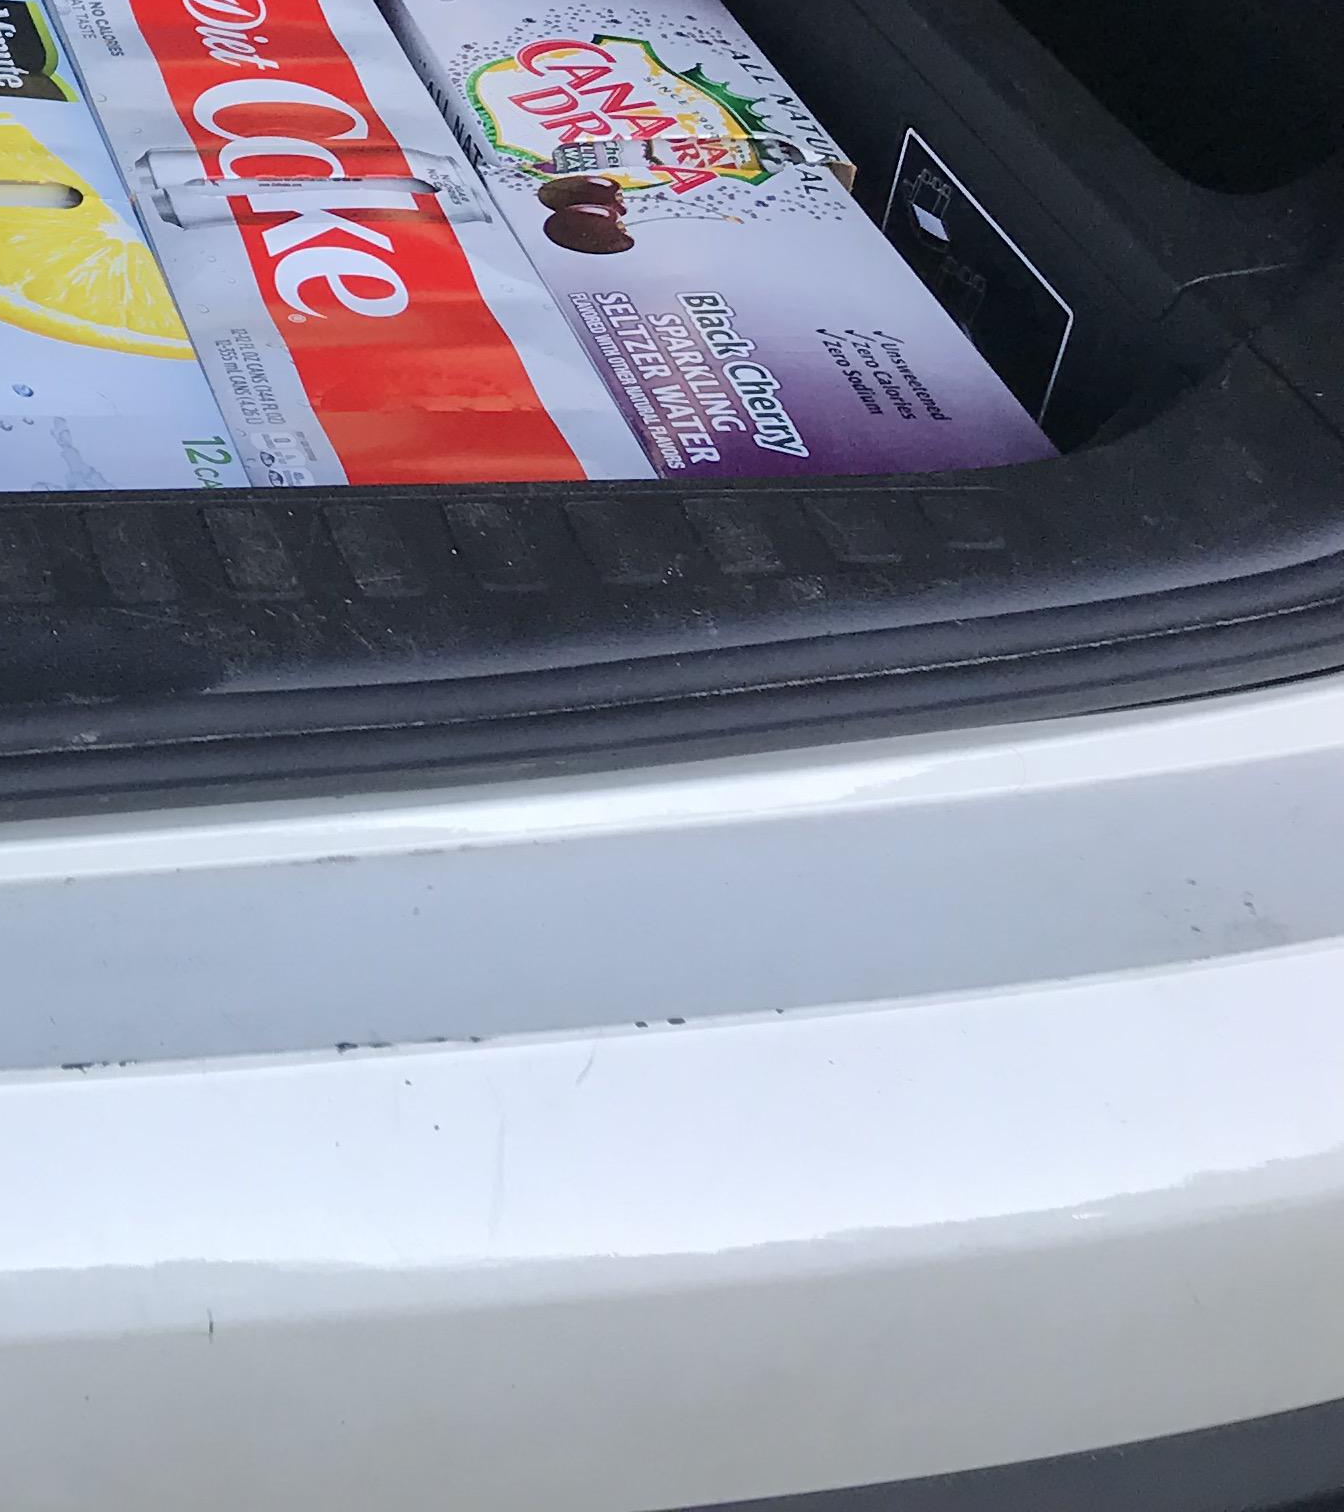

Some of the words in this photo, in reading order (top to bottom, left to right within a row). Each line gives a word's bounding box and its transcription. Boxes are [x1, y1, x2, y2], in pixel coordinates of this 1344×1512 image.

[76, 13, 98, 40] TASTE
[89, 1, 105, 17] NO
[95, 19, 125, 57] CALORIES
[722, 47, 775, 85] ALL
[508, 86, 624, 143] DR
[517, 39, 720, 195] CANAA
[193, 78, 420, 319] Coke
[229, 375, 253, 396] CANS
[246, 362, 269, 385] CANS
[568, 292, 607, 334] FLAVORED
[594, 333, 618, 357] WITH
[608, 355, 637, 386] OTHER
[624, 385, 660, 428] NATURAL
[648, 423, 686, 470] FLAVORS
[594, 291, 672, 381] SELTZER
[650, 385, 721, 464] WATER
[647, 313, 747, 432] SPARKLING
[680, 293, 754, 358] Black
[725, 362, 805, 455] Cherry
[822, 340, 850, 367] Zero
[842, 369, 883, 415] Sodium
[851, 341, 879, 368] Zero
[873, 371, 917, 420] Calories
[881, 342, 952, 421] Unsweetened
[182, 436, 232, 464] 12
